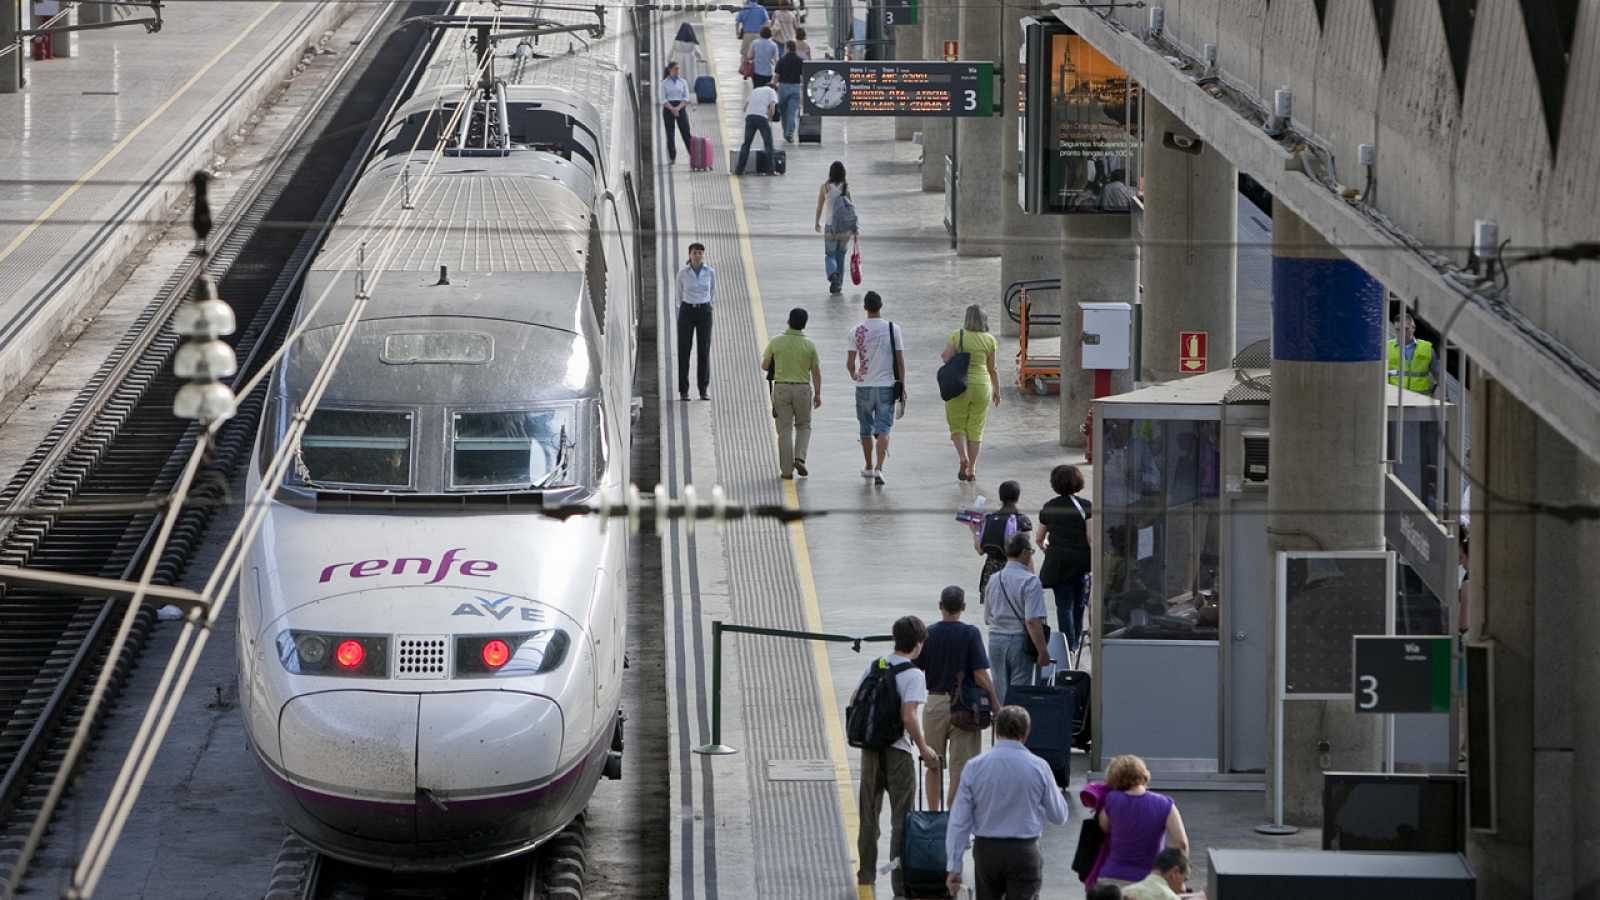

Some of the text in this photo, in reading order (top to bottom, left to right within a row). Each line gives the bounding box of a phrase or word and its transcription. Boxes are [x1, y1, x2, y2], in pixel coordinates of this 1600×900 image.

[886, 11, 894, 25] 3
[963, 89, 977, 111] 3
[318, 547, 498, 584] renfe
[451, 596, 545, 622] AVE
[1359, 675, 1379, 709] 3
